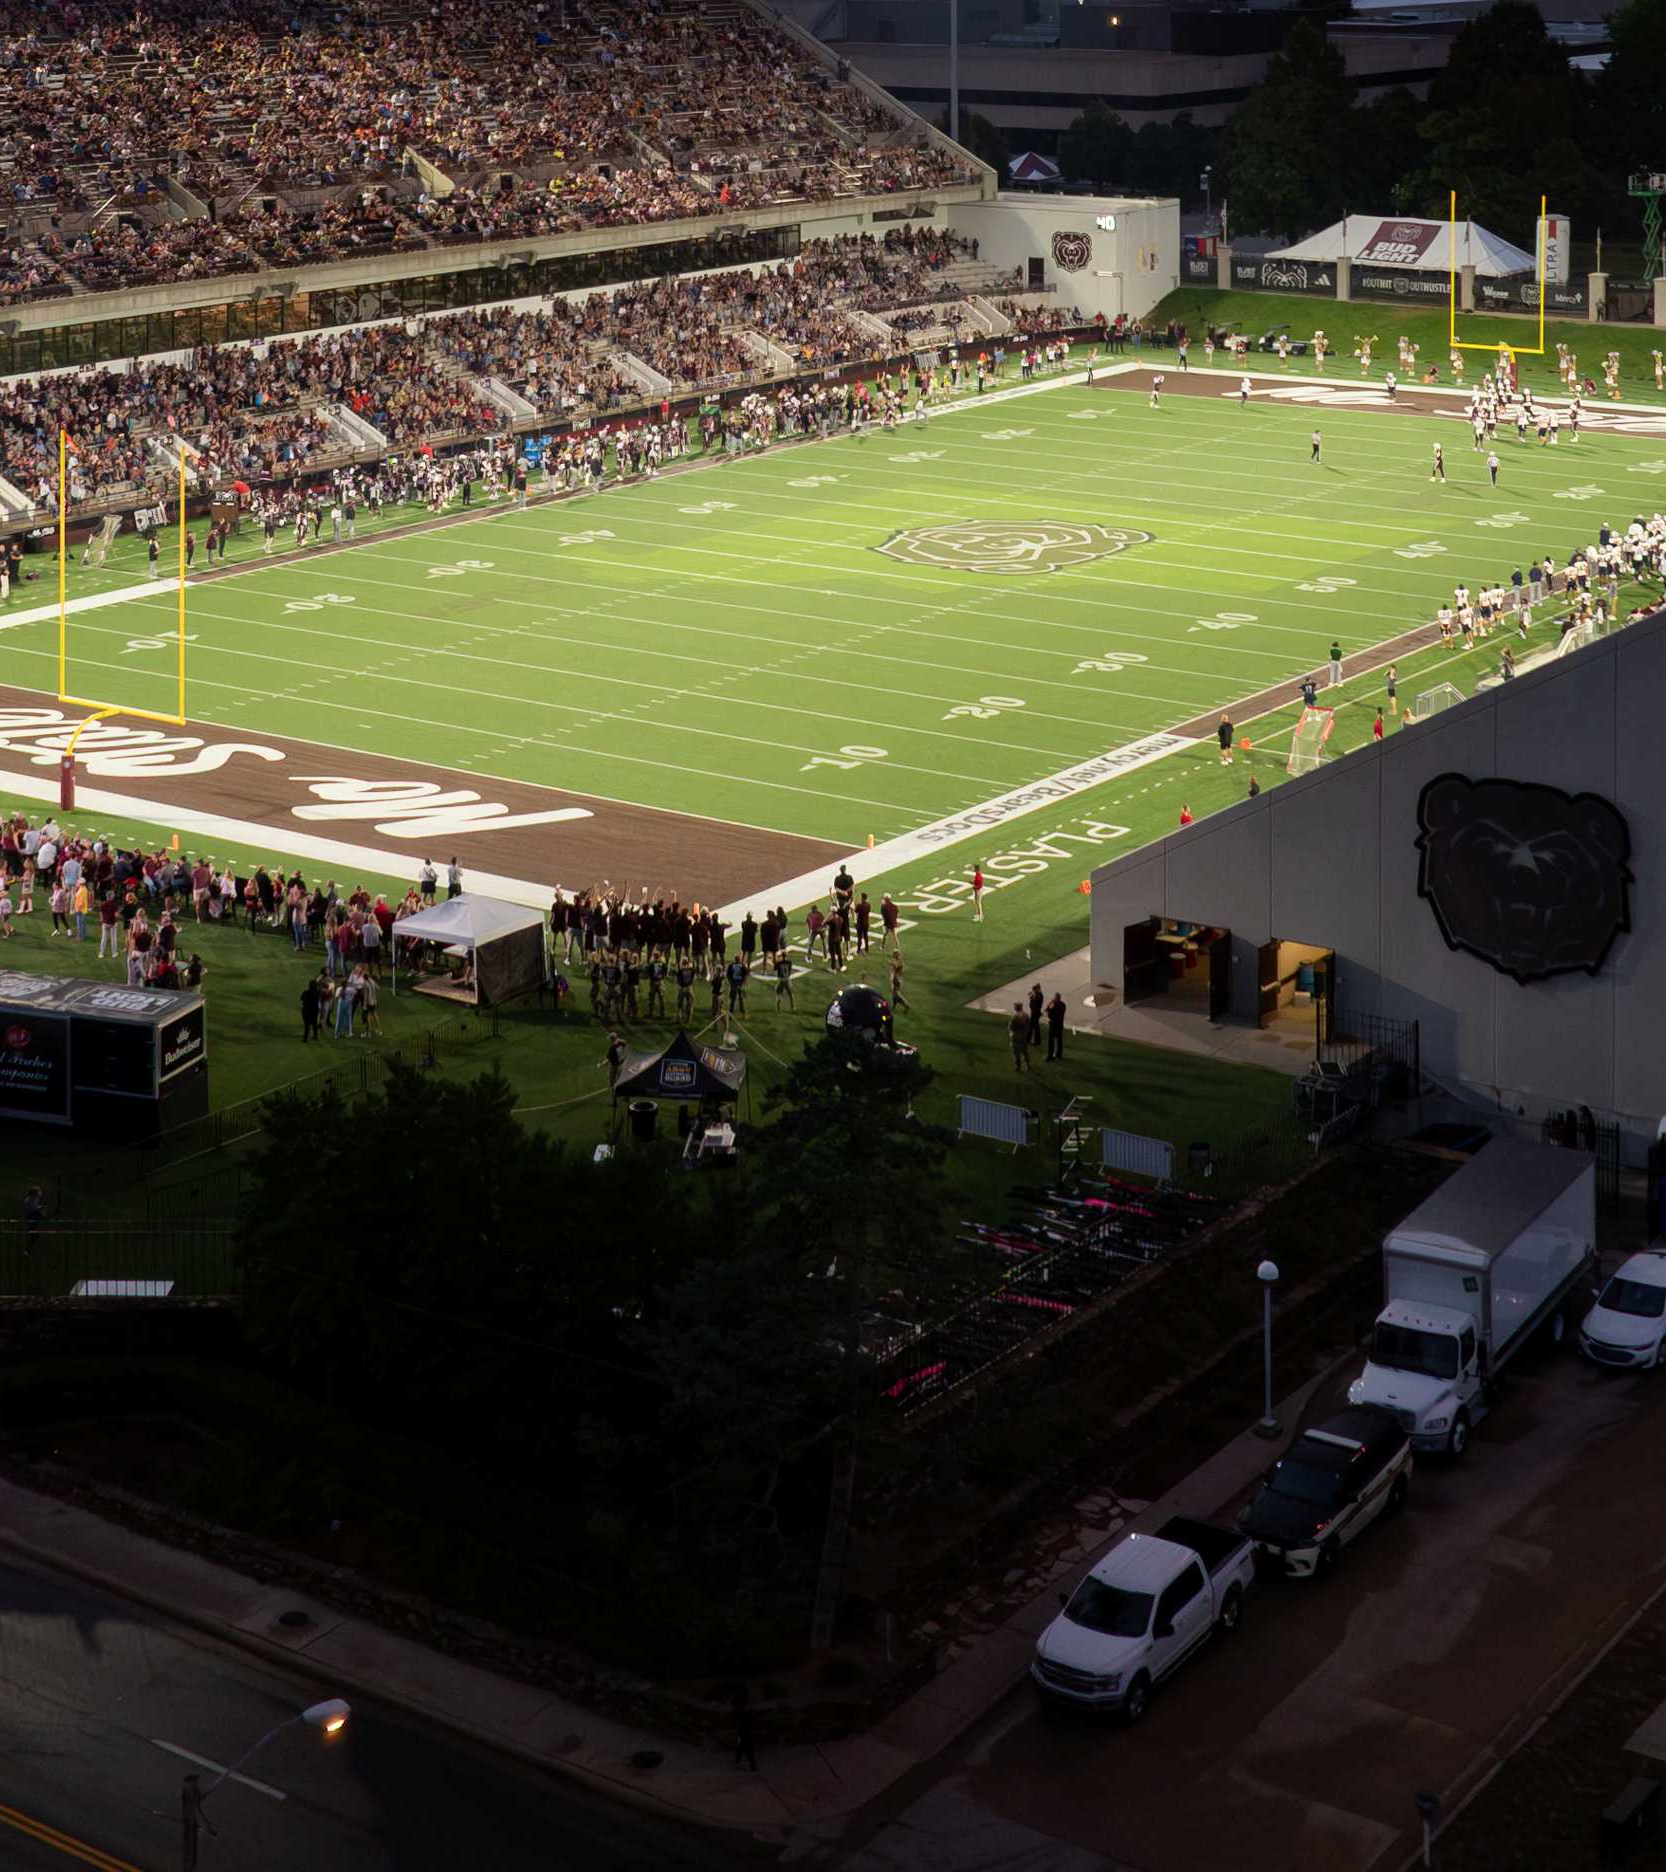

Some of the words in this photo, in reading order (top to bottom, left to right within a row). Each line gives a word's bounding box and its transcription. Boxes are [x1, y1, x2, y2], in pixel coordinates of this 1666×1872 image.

[1096, 215, 1116, 230] 40
[1358, 250, 1421, 264] LIGHT
[1374, 241, 1418, 254] BUD
[1546, 242, 1558, 281] LTRA
[1555, 292, 1576, 304] Mercy
[948, 695, 1026, 720] 20
[813, 745, 889, 770] 10
[916, 735, 1182, 843] mercy.net/BearsDocs
[889, 818, 1131, 914] PLASTER
